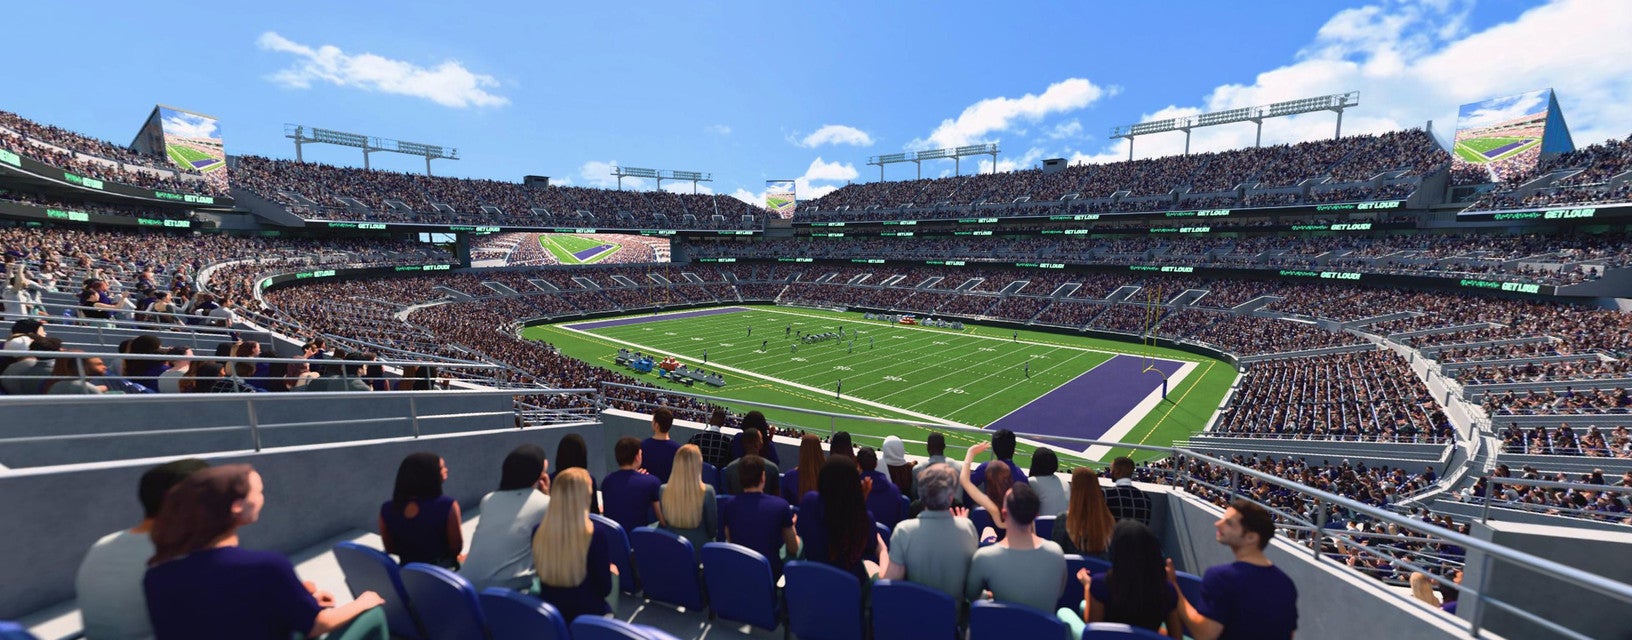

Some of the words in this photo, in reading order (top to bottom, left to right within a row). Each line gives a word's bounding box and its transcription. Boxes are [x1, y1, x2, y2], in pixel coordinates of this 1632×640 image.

[1357, 202, 1374, 210] GET
[1374, 201, 1400, 209] LOUD!
[1544, 210, 1564, 219] GET
[1564, 208, 1595, 218] LOUD!
[1320, 271, 1337, 279] GET
[1337, 272, 1361, 280] LOUD!
[1501, 282, 1519, 291] GET
